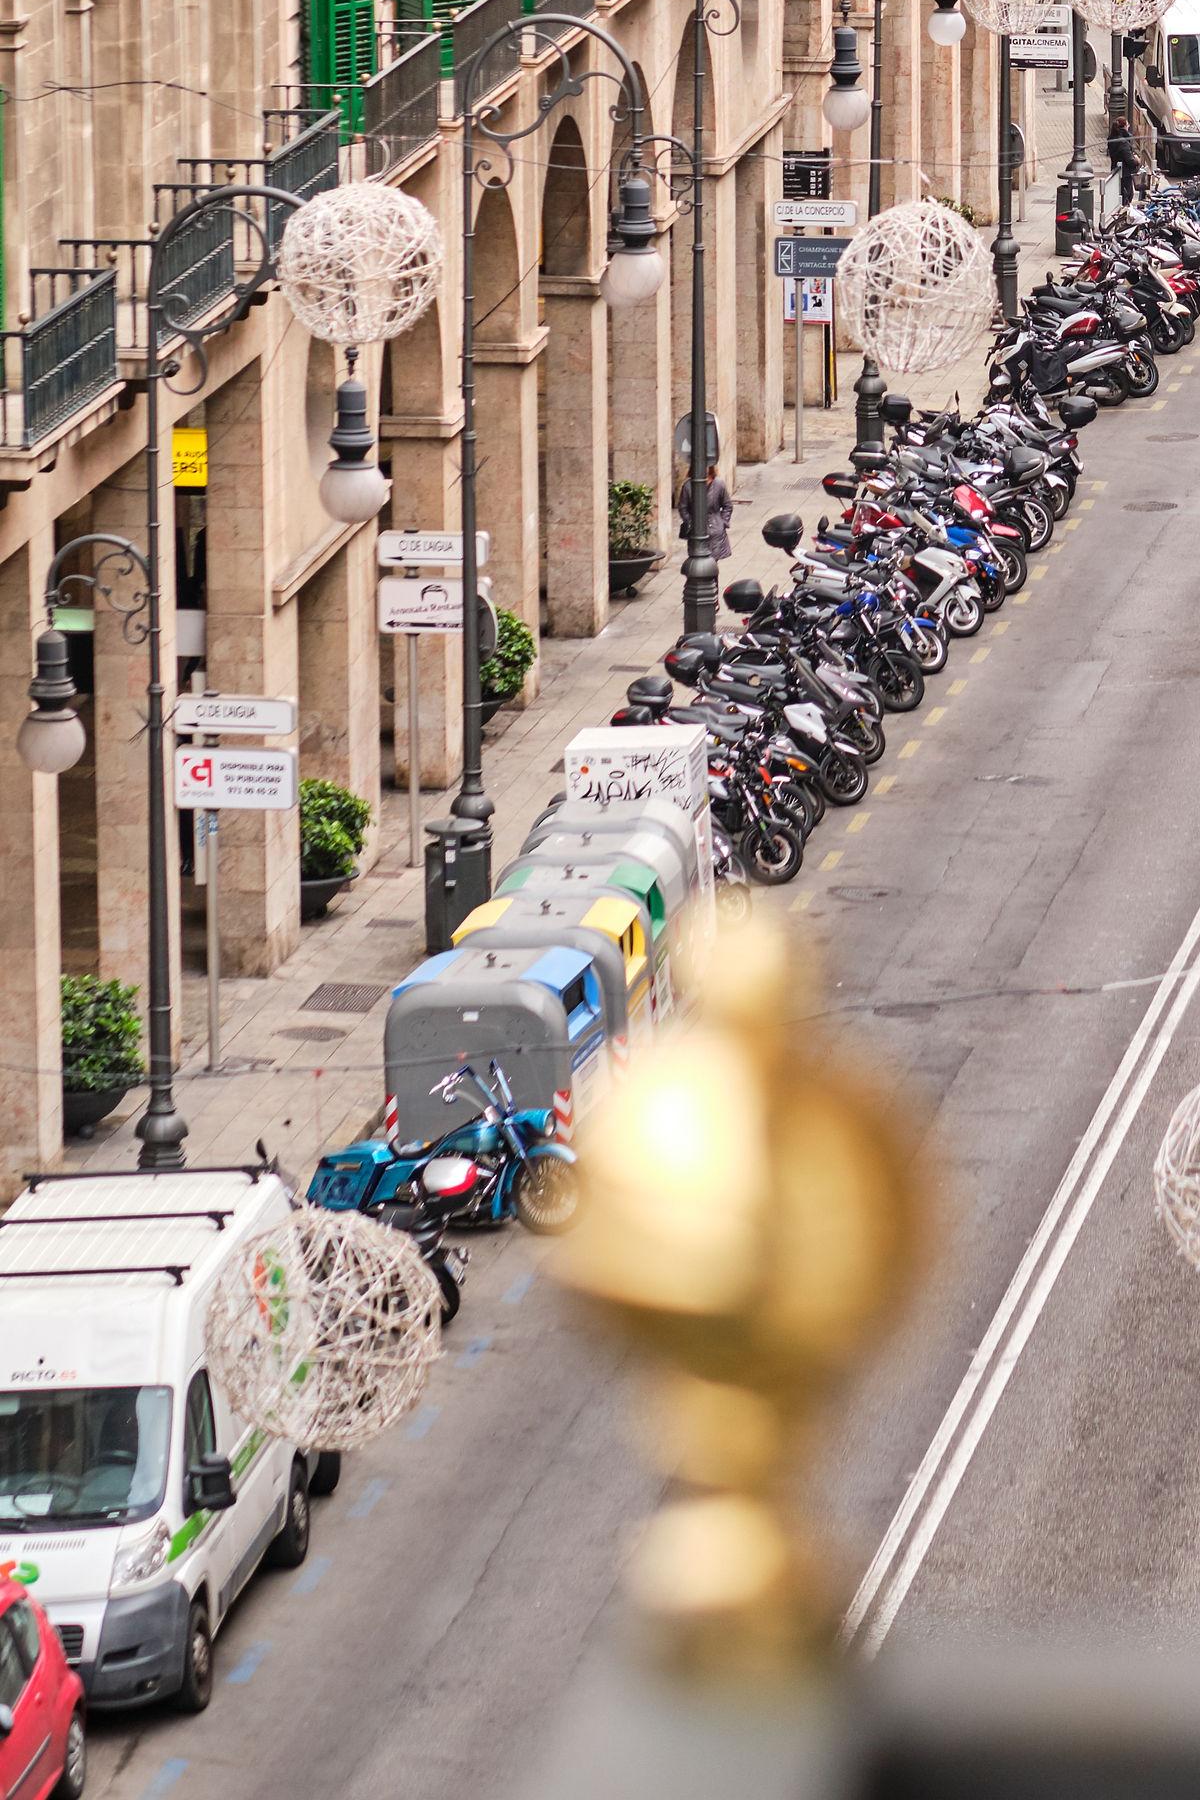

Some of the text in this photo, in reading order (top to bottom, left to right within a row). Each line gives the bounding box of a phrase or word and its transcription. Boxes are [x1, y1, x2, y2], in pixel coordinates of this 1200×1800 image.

[1009, 38, 1067, 47] IGITALCINEMA
[785, 205, 794, 215] DE
[795, 205, 803, 215] LA
[410, 540, 421, 551] DE
[207, 704, 219, 718] DE
[220, 762, 284, 772] DISPONIBLE PARA
[236, 774, 282, 783] PUBLICIDAD
